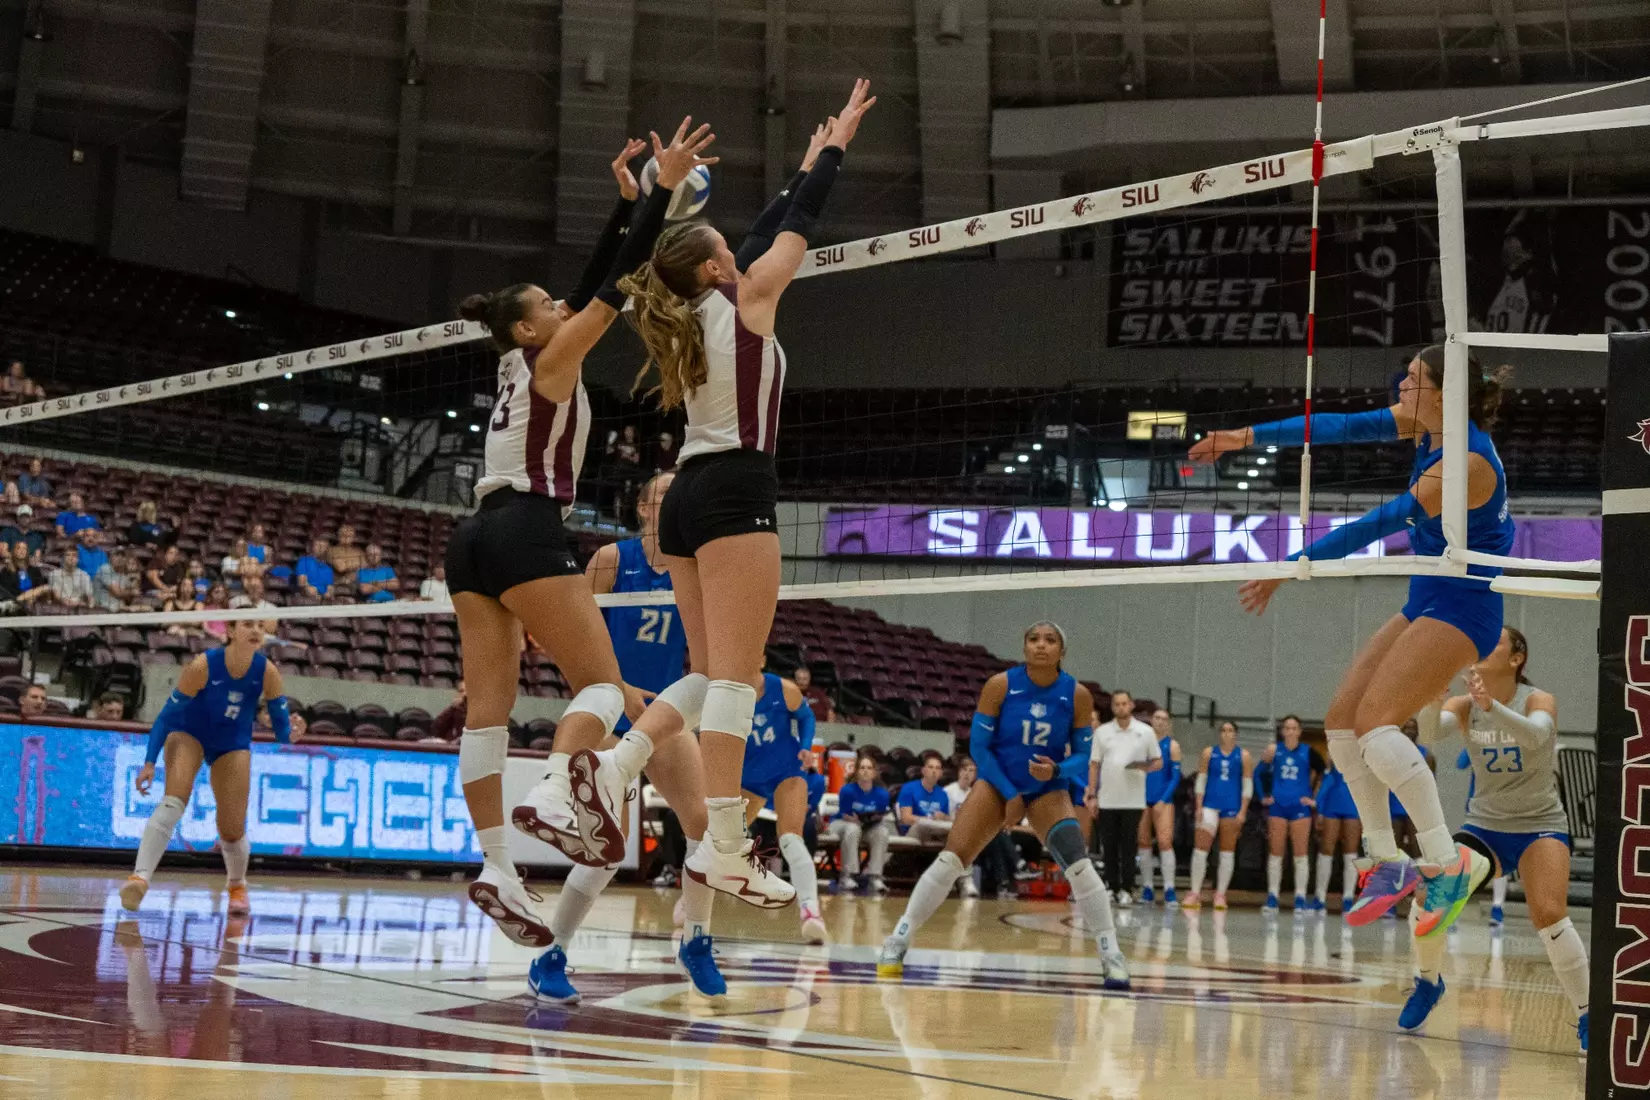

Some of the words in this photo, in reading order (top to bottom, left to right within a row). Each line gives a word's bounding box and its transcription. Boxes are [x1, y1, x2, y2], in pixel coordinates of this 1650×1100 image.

[1419, 126, 1443, 136] Senoh
[815, 247, 845, 267] SIU
[908, 227, 941, 249] SIU
[1010, 206, 1045, 230] SIU
[1121, 184, 1160, 209] SIU
[1244, 159, 1285, 184] SIU
[1122, 226, 1316, 255] SALUKIS
[1120, 277, 1277, 307] SWEET
[1351, 214, 1398, 346] 1977
[1118, 312, 1309, 342] SIXTEEN
[180, 374, 196, 387] SIU
[226, 366, 243, 379] SIU
[276, 355, 293, 370] SIU
[328, 344, 347, 360] SIU
[384, 333, 403, 349] SIU
[443, 322, 464, 338] SIU
[927, 511, 1388, 562] SALUKI
[636, 608, 672, 645] 21
[752, 726, 776, 747] 14
[1021, 719, 1052, 747] 12
[1482, 746, 1524, 773] 23
